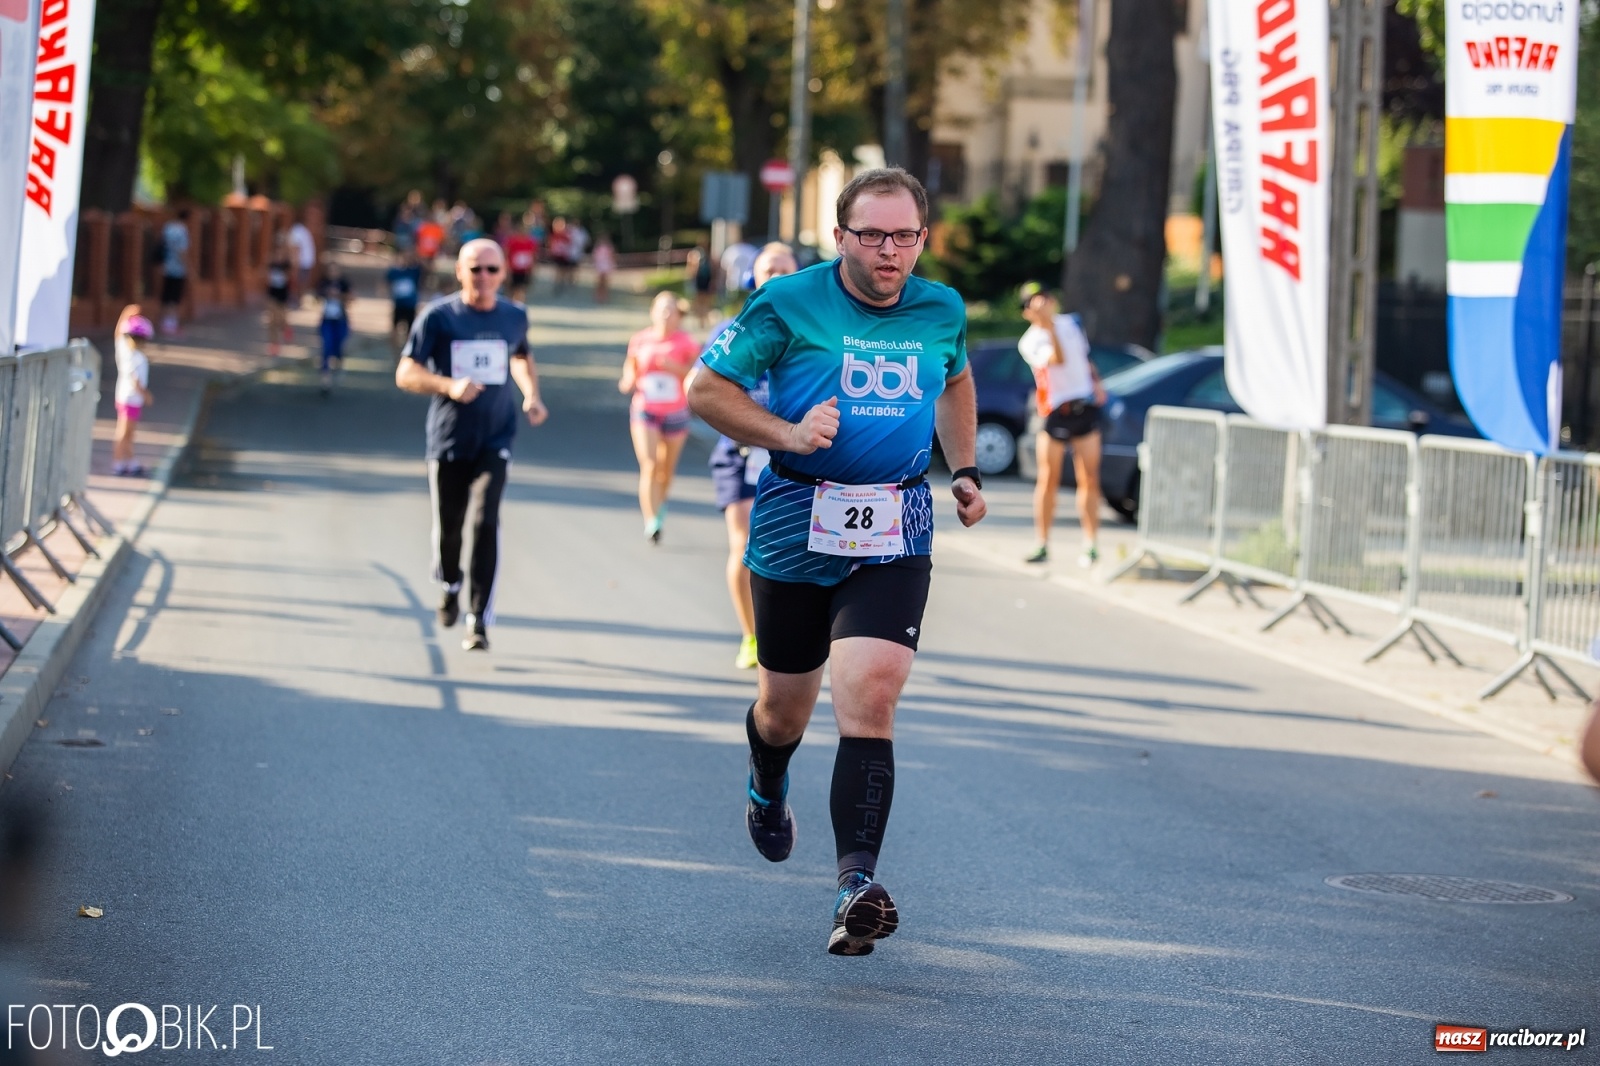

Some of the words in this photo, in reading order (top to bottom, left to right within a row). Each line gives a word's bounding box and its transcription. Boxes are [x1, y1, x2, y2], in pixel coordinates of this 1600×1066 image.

[843, 335, 923, 351] BiegamBoLubię
[841, 352, 924, 400] bbl
[851, 405, 905, 417] RACIBÓRZ
[844, 506, 874, 529] 28
[856, 760, 892, 845] Kalenji
